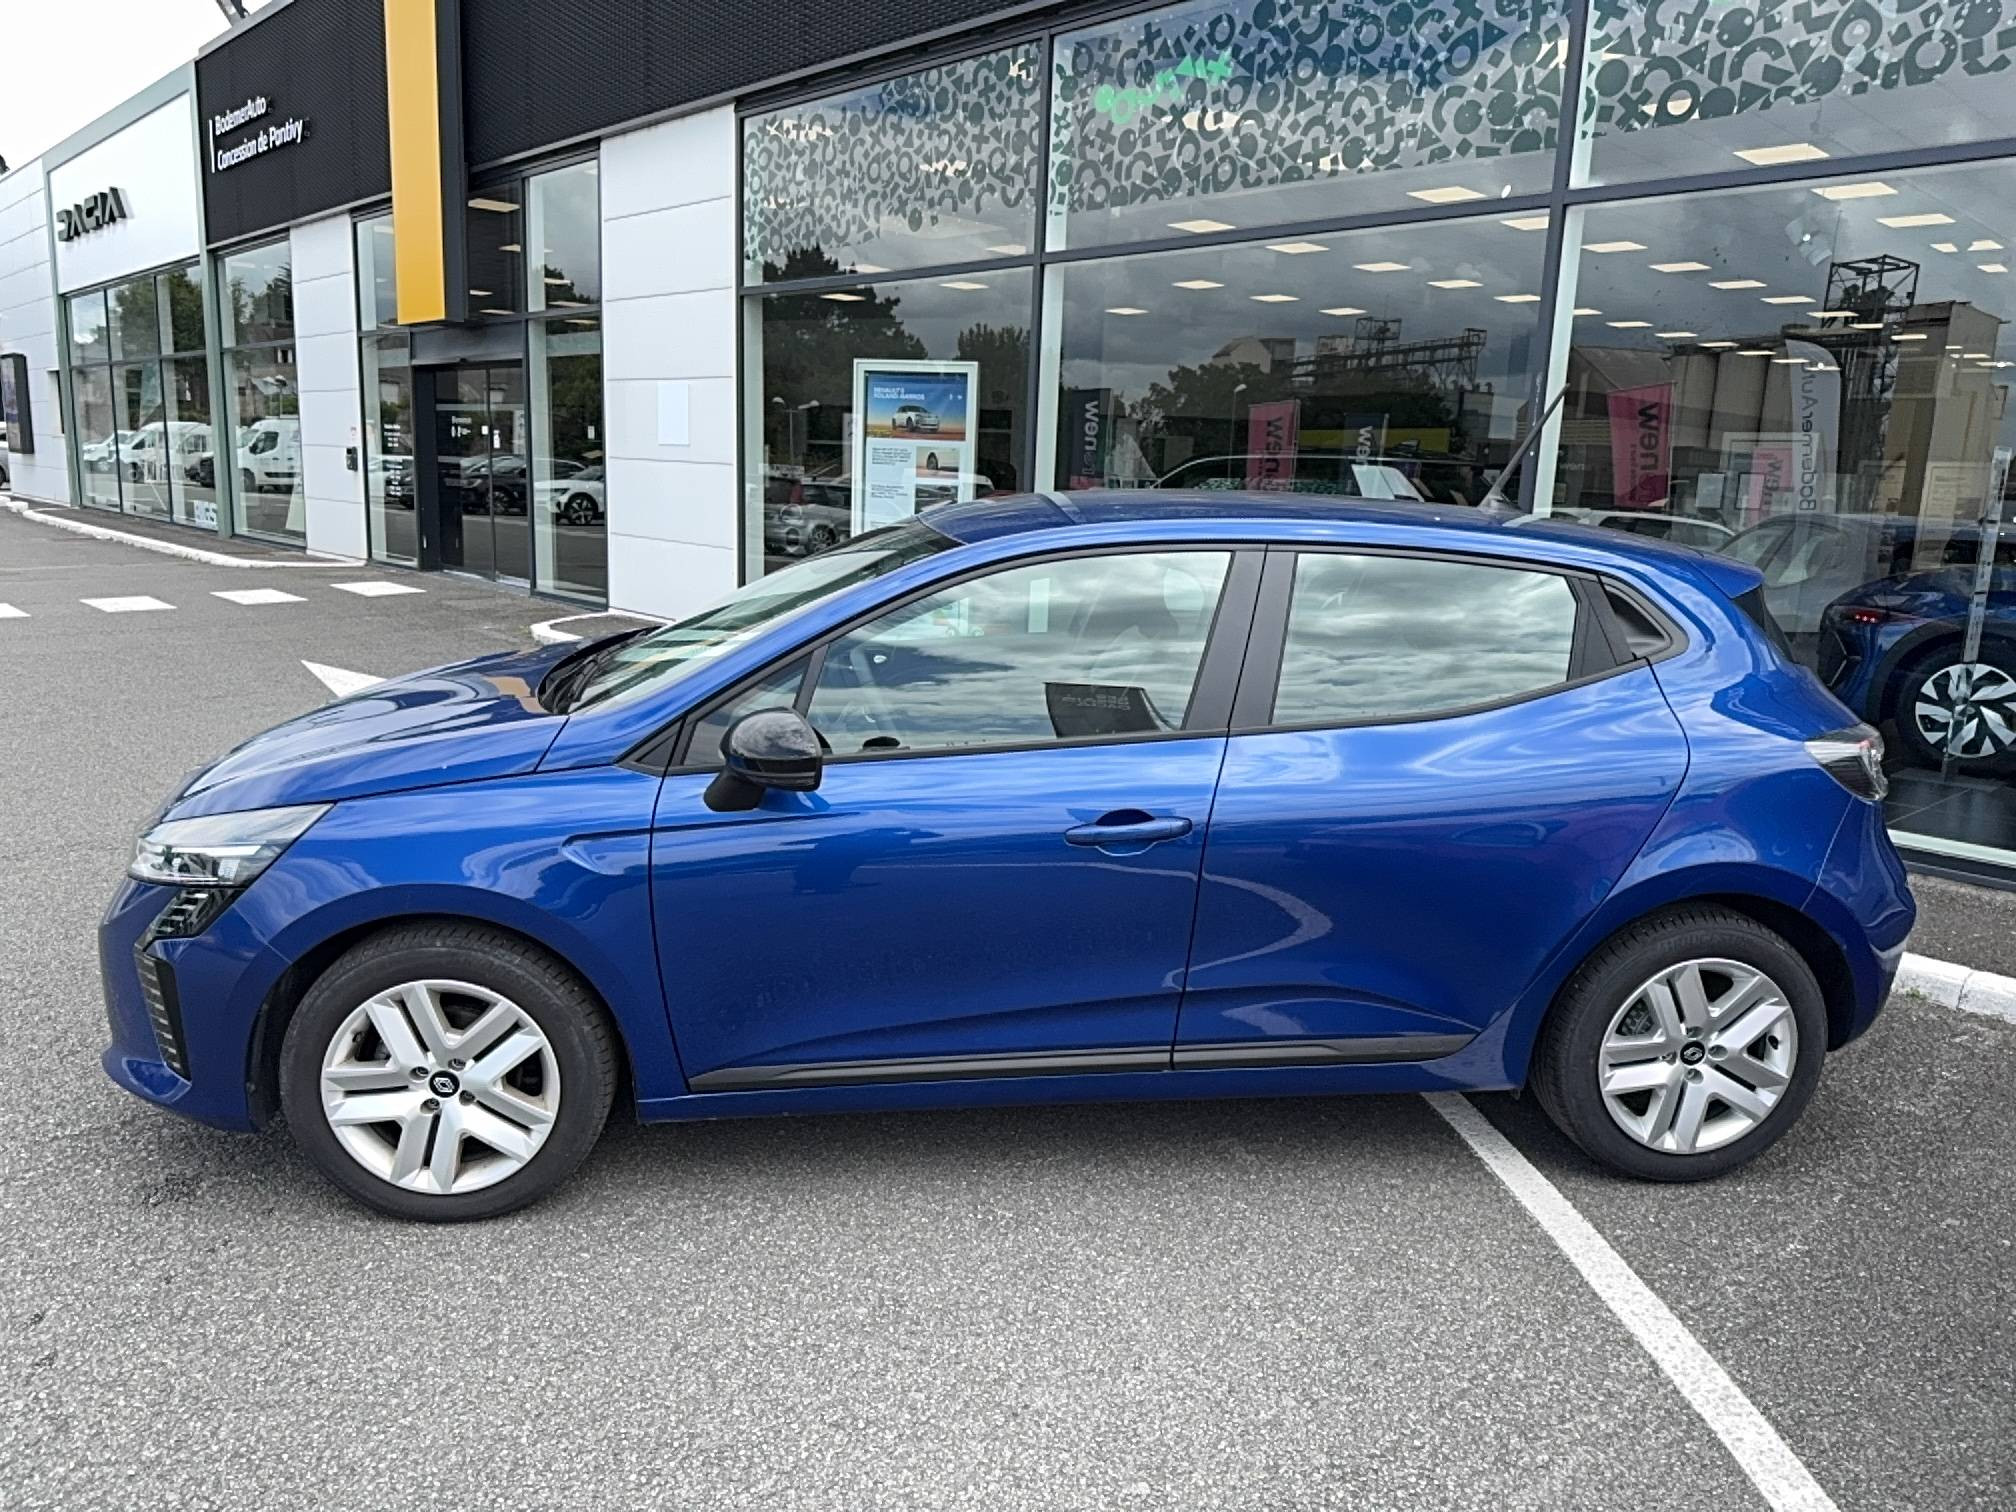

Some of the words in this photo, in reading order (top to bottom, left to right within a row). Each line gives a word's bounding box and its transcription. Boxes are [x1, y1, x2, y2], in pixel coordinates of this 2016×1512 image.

[215, 96, 266, 135] BodemerAuto
[218, 138, 257, 170] Concession
[257, 131, 268, 153] de
[56, 186, 126, 242] DACIA
